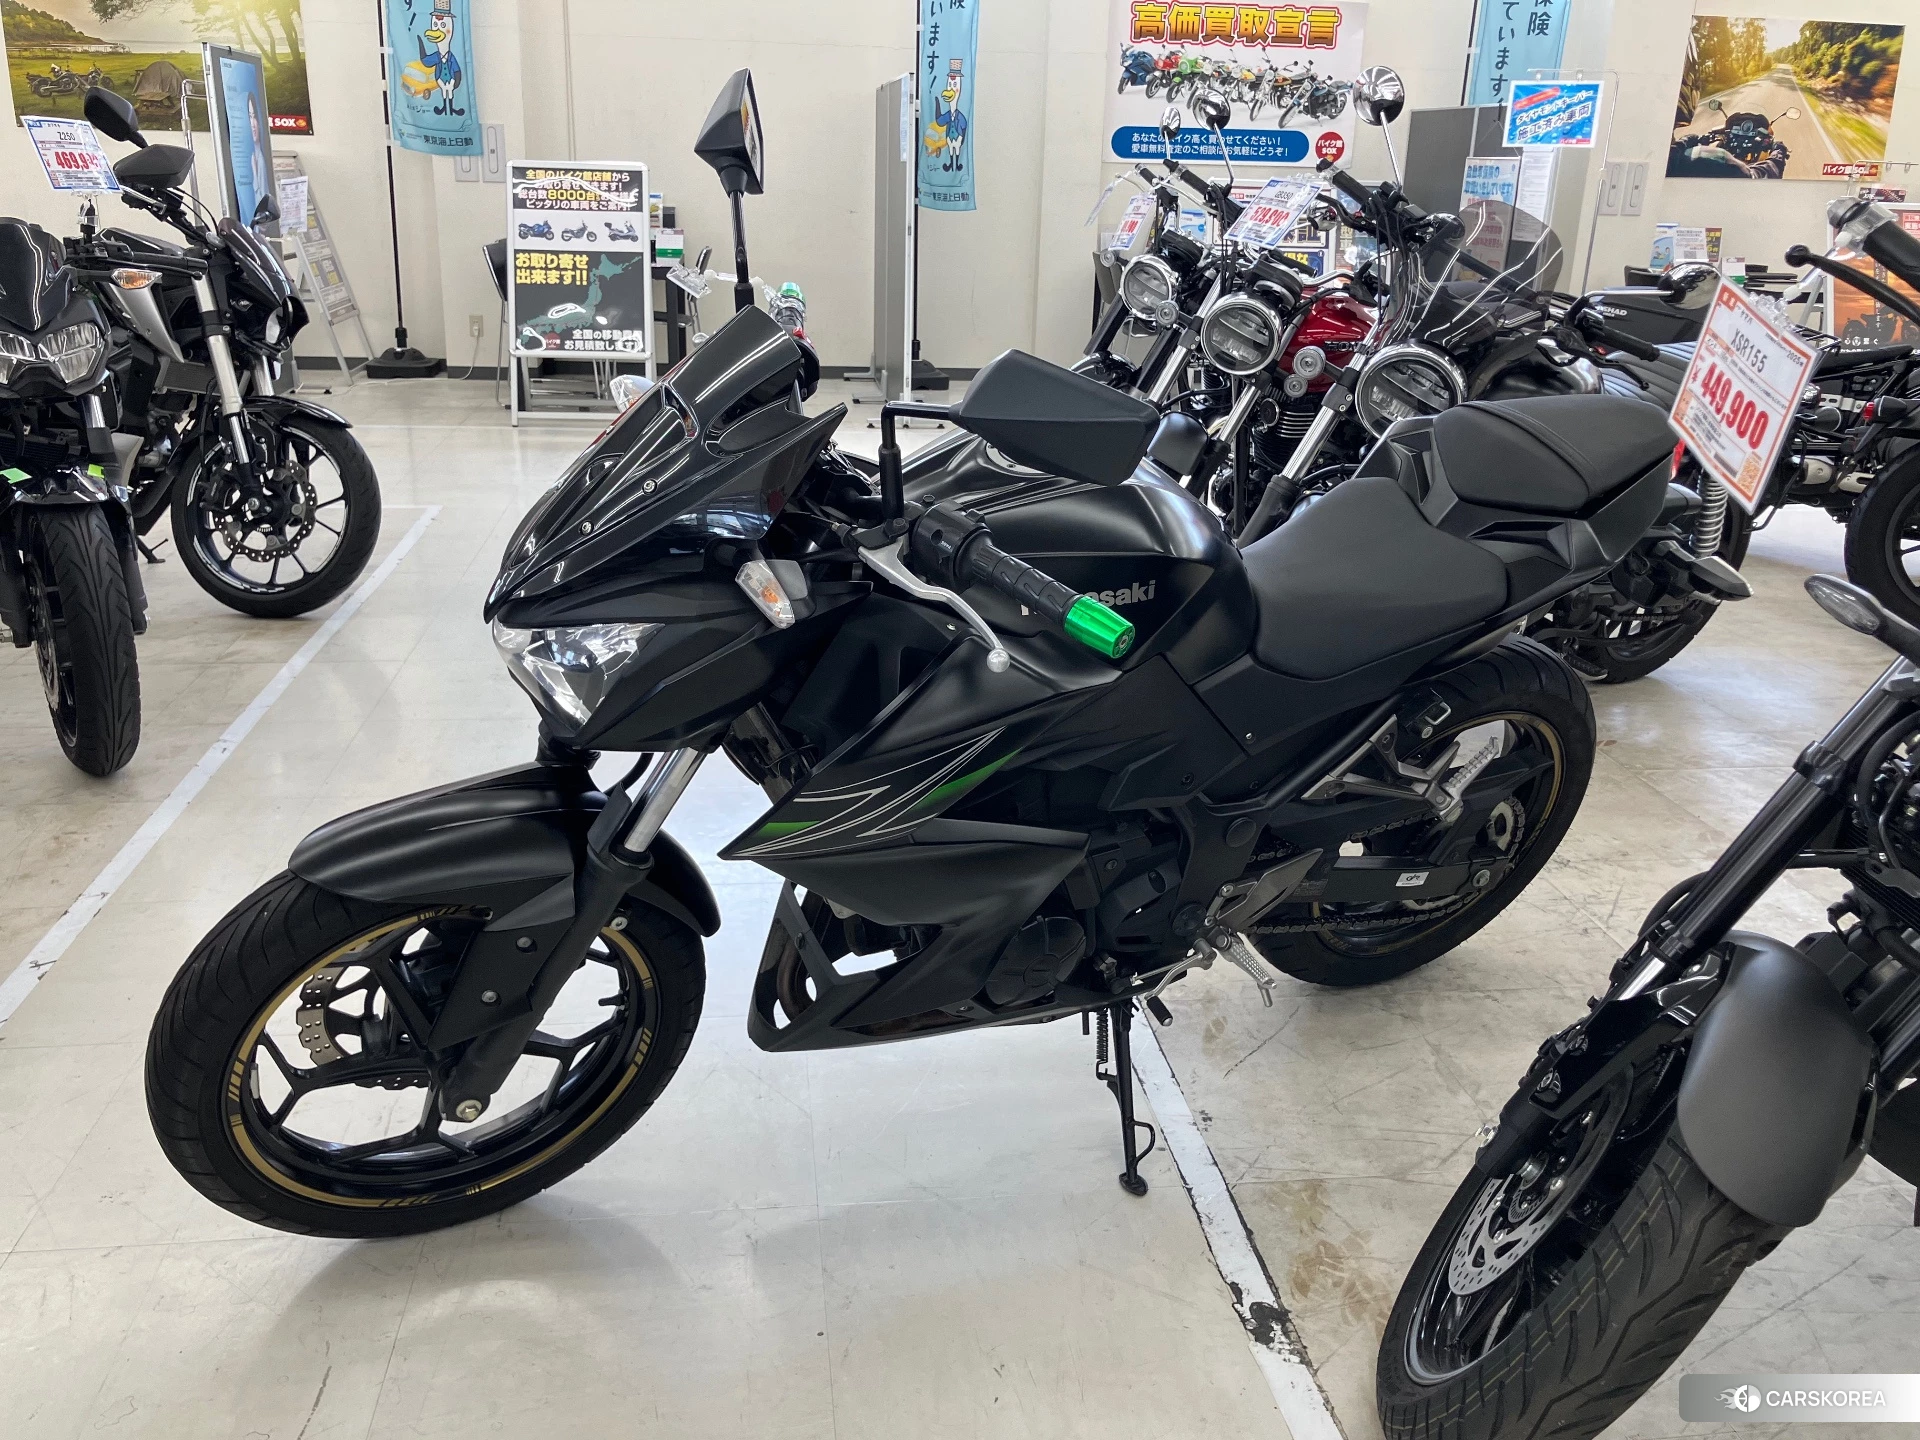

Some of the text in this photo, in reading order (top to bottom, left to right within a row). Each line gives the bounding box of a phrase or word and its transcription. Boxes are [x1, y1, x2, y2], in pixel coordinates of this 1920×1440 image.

[1132, 3, 1341, 48] 高価買取宣言
[1516, 103, 1592, 141] 施工済み車両
[57, 131, 76, 141] Z250
[423, 134, 474, 147] 東京海上日動
[1132, 132, 1281, 146] あなたのイク高く買わせてください!
[1318, 140, 1343, 148] バイク館
[54, 151, 99, 170] 469,9
[533, 180, 623, 192] 取り寄せきます!
[515, 252, 589, 269] お取り寄せ
[515, 268, 588, 286] 出来ます!!
[1730, 328, 1768, 374] XSR155
[1700, 361, 1769, 450] 449,900
